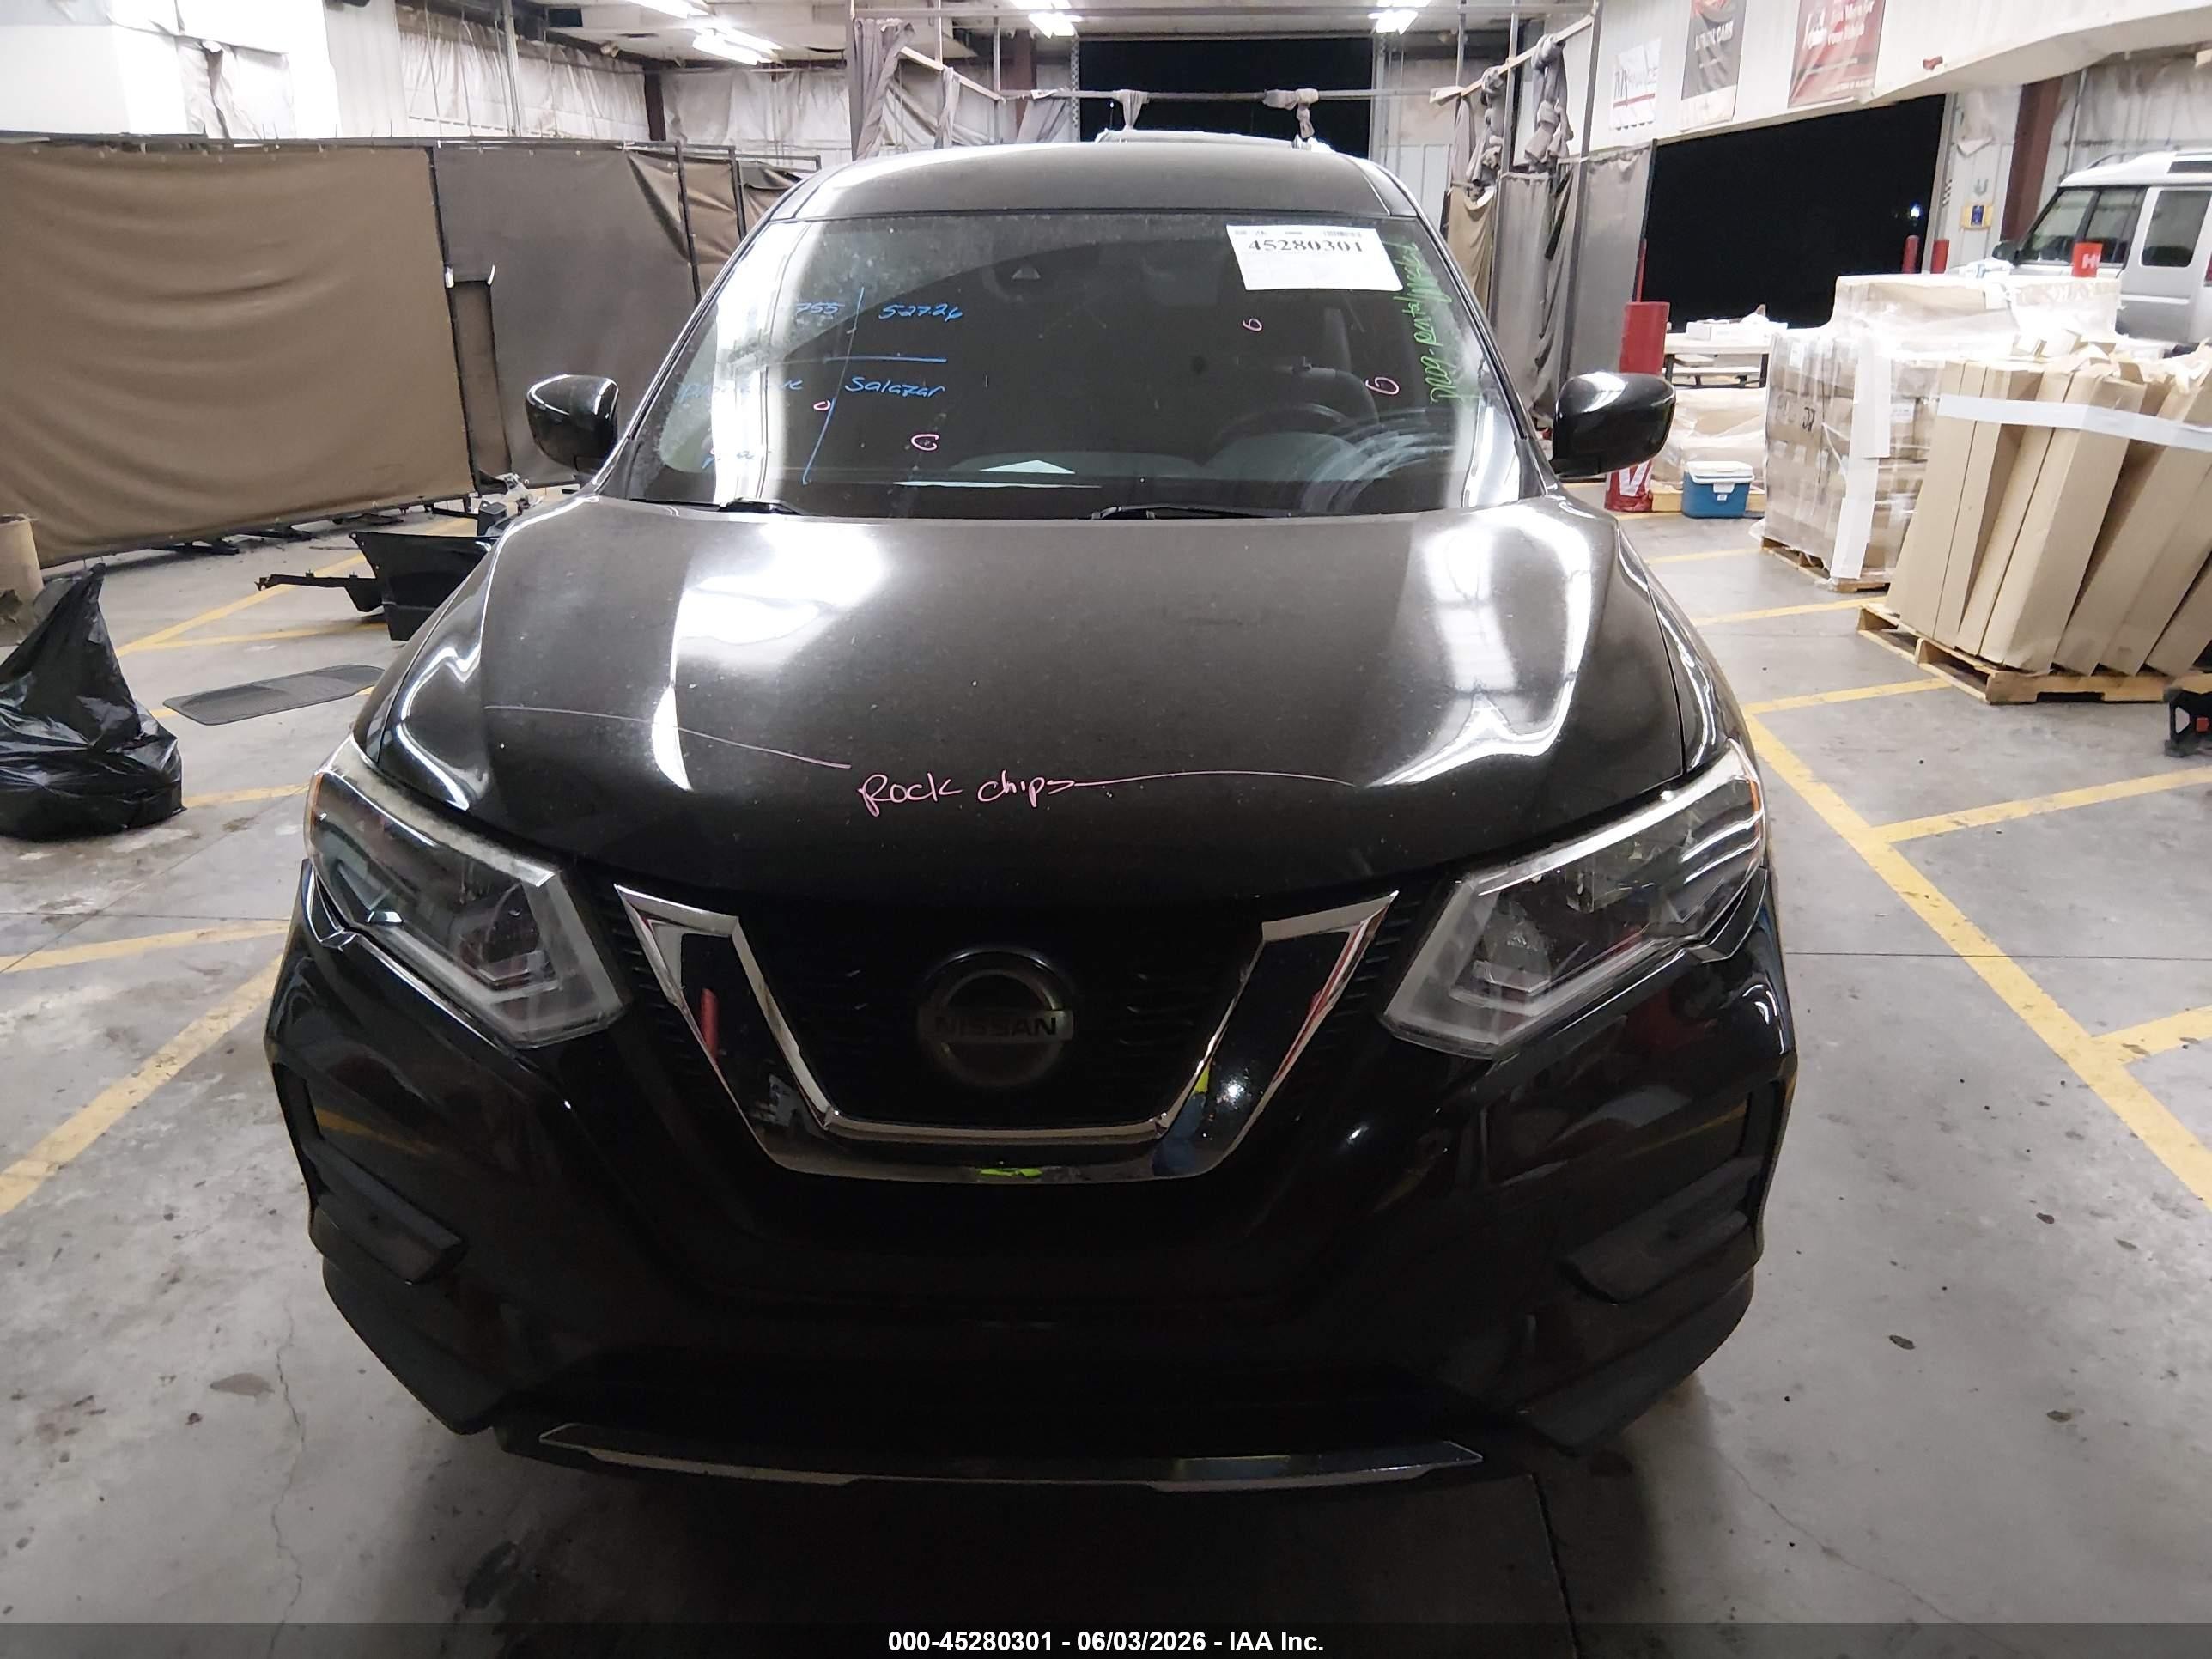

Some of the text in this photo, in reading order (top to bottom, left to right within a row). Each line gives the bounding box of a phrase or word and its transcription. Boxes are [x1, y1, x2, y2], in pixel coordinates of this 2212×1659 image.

[1249, 240, 1364, 252] 45280301
[844, 376, 945, 398] Salazar
[857, 769, 1075, 817] Rock chips
[933, 1016, 1058, 1036] NISSAN
